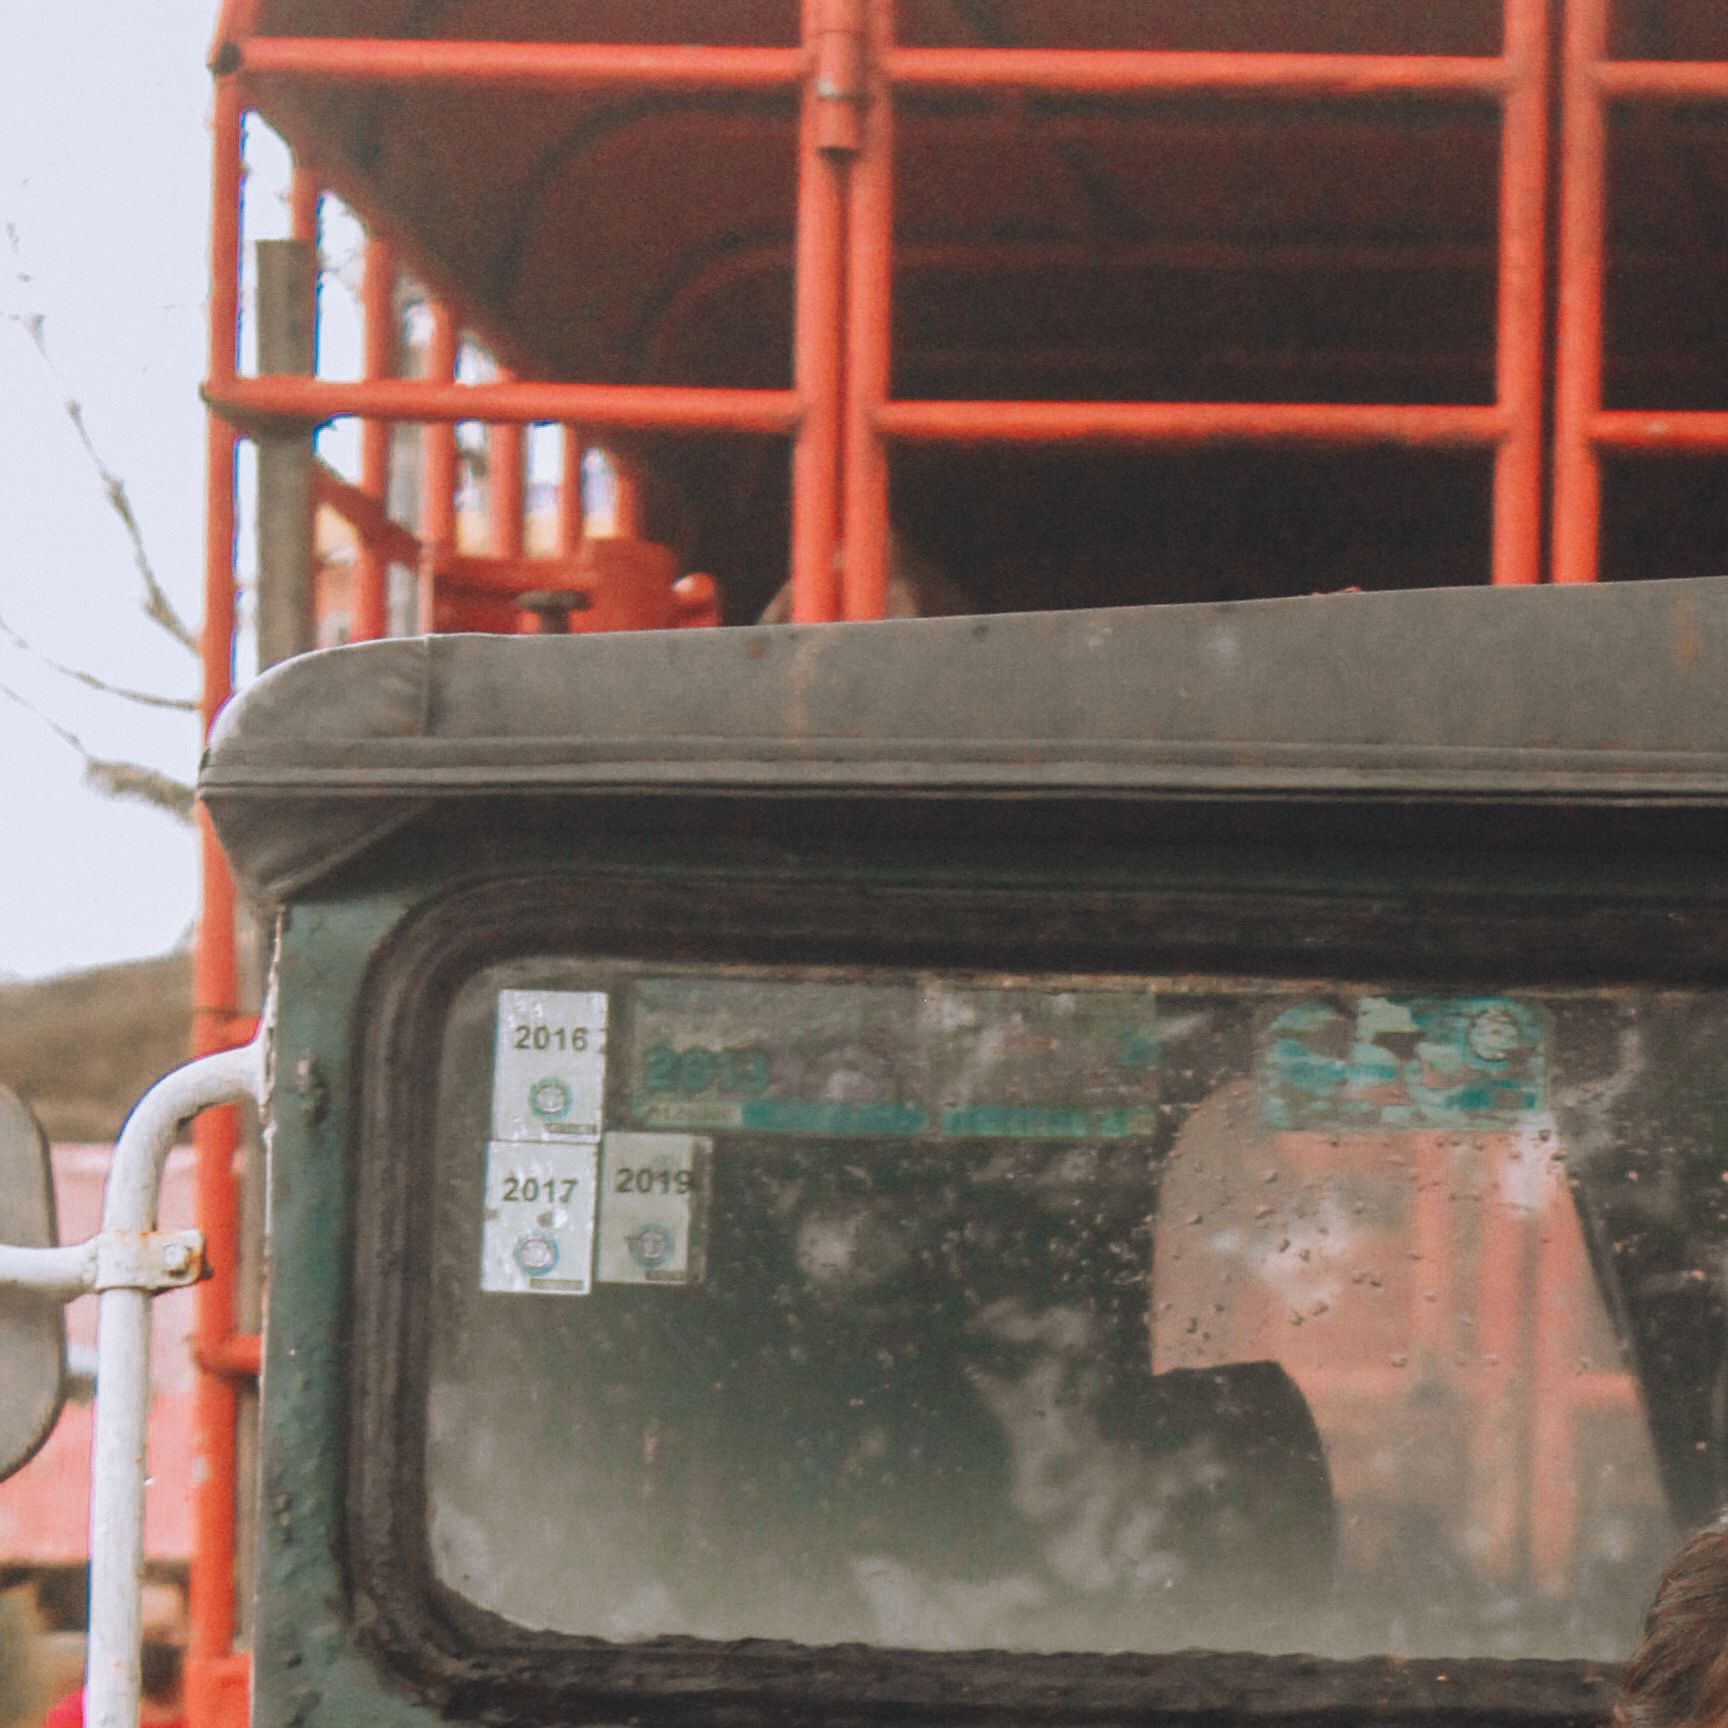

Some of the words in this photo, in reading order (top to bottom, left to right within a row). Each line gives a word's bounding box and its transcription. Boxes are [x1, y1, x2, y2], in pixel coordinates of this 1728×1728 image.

[515, 1026, 588, 1051] 2016
[503, 1178, 577, 1203] 2017
[616, 1168, 693, 1194] 2019
